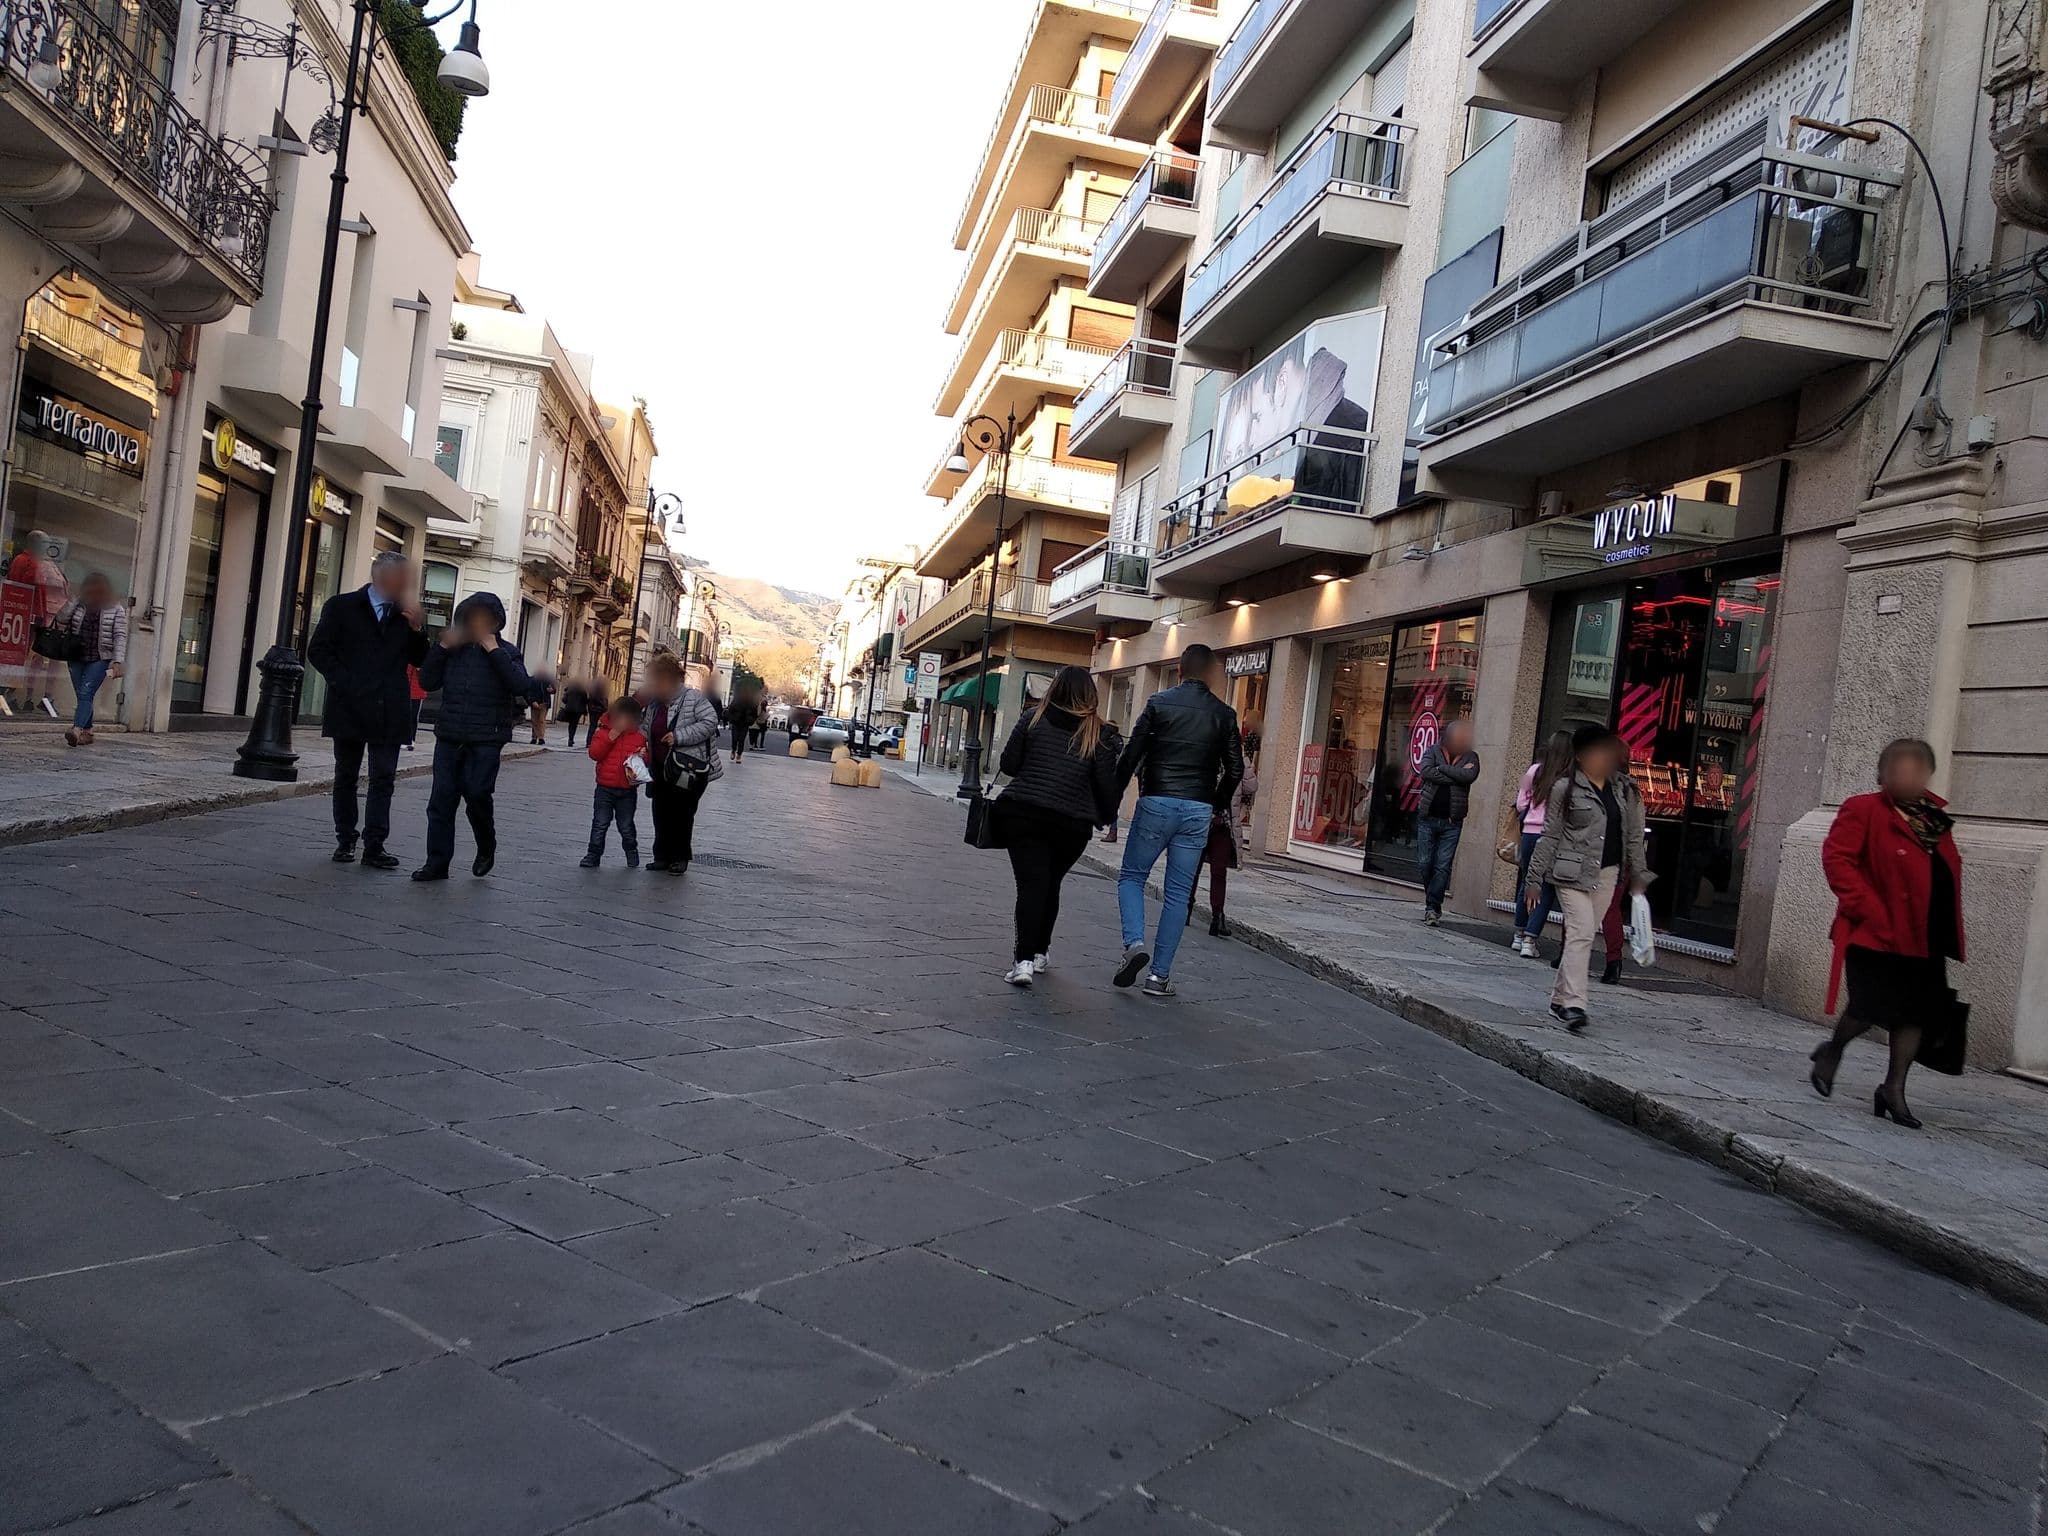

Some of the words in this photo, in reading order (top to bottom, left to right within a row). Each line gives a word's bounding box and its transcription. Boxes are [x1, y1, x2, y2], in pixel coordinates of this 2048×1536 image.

[1594, 495, 1674, 549] WYCON
[1605, 544, 1651, 562] cosmetics
[1, 612, 23, 645] 50
[1297, 774, 1318, 831] 50
